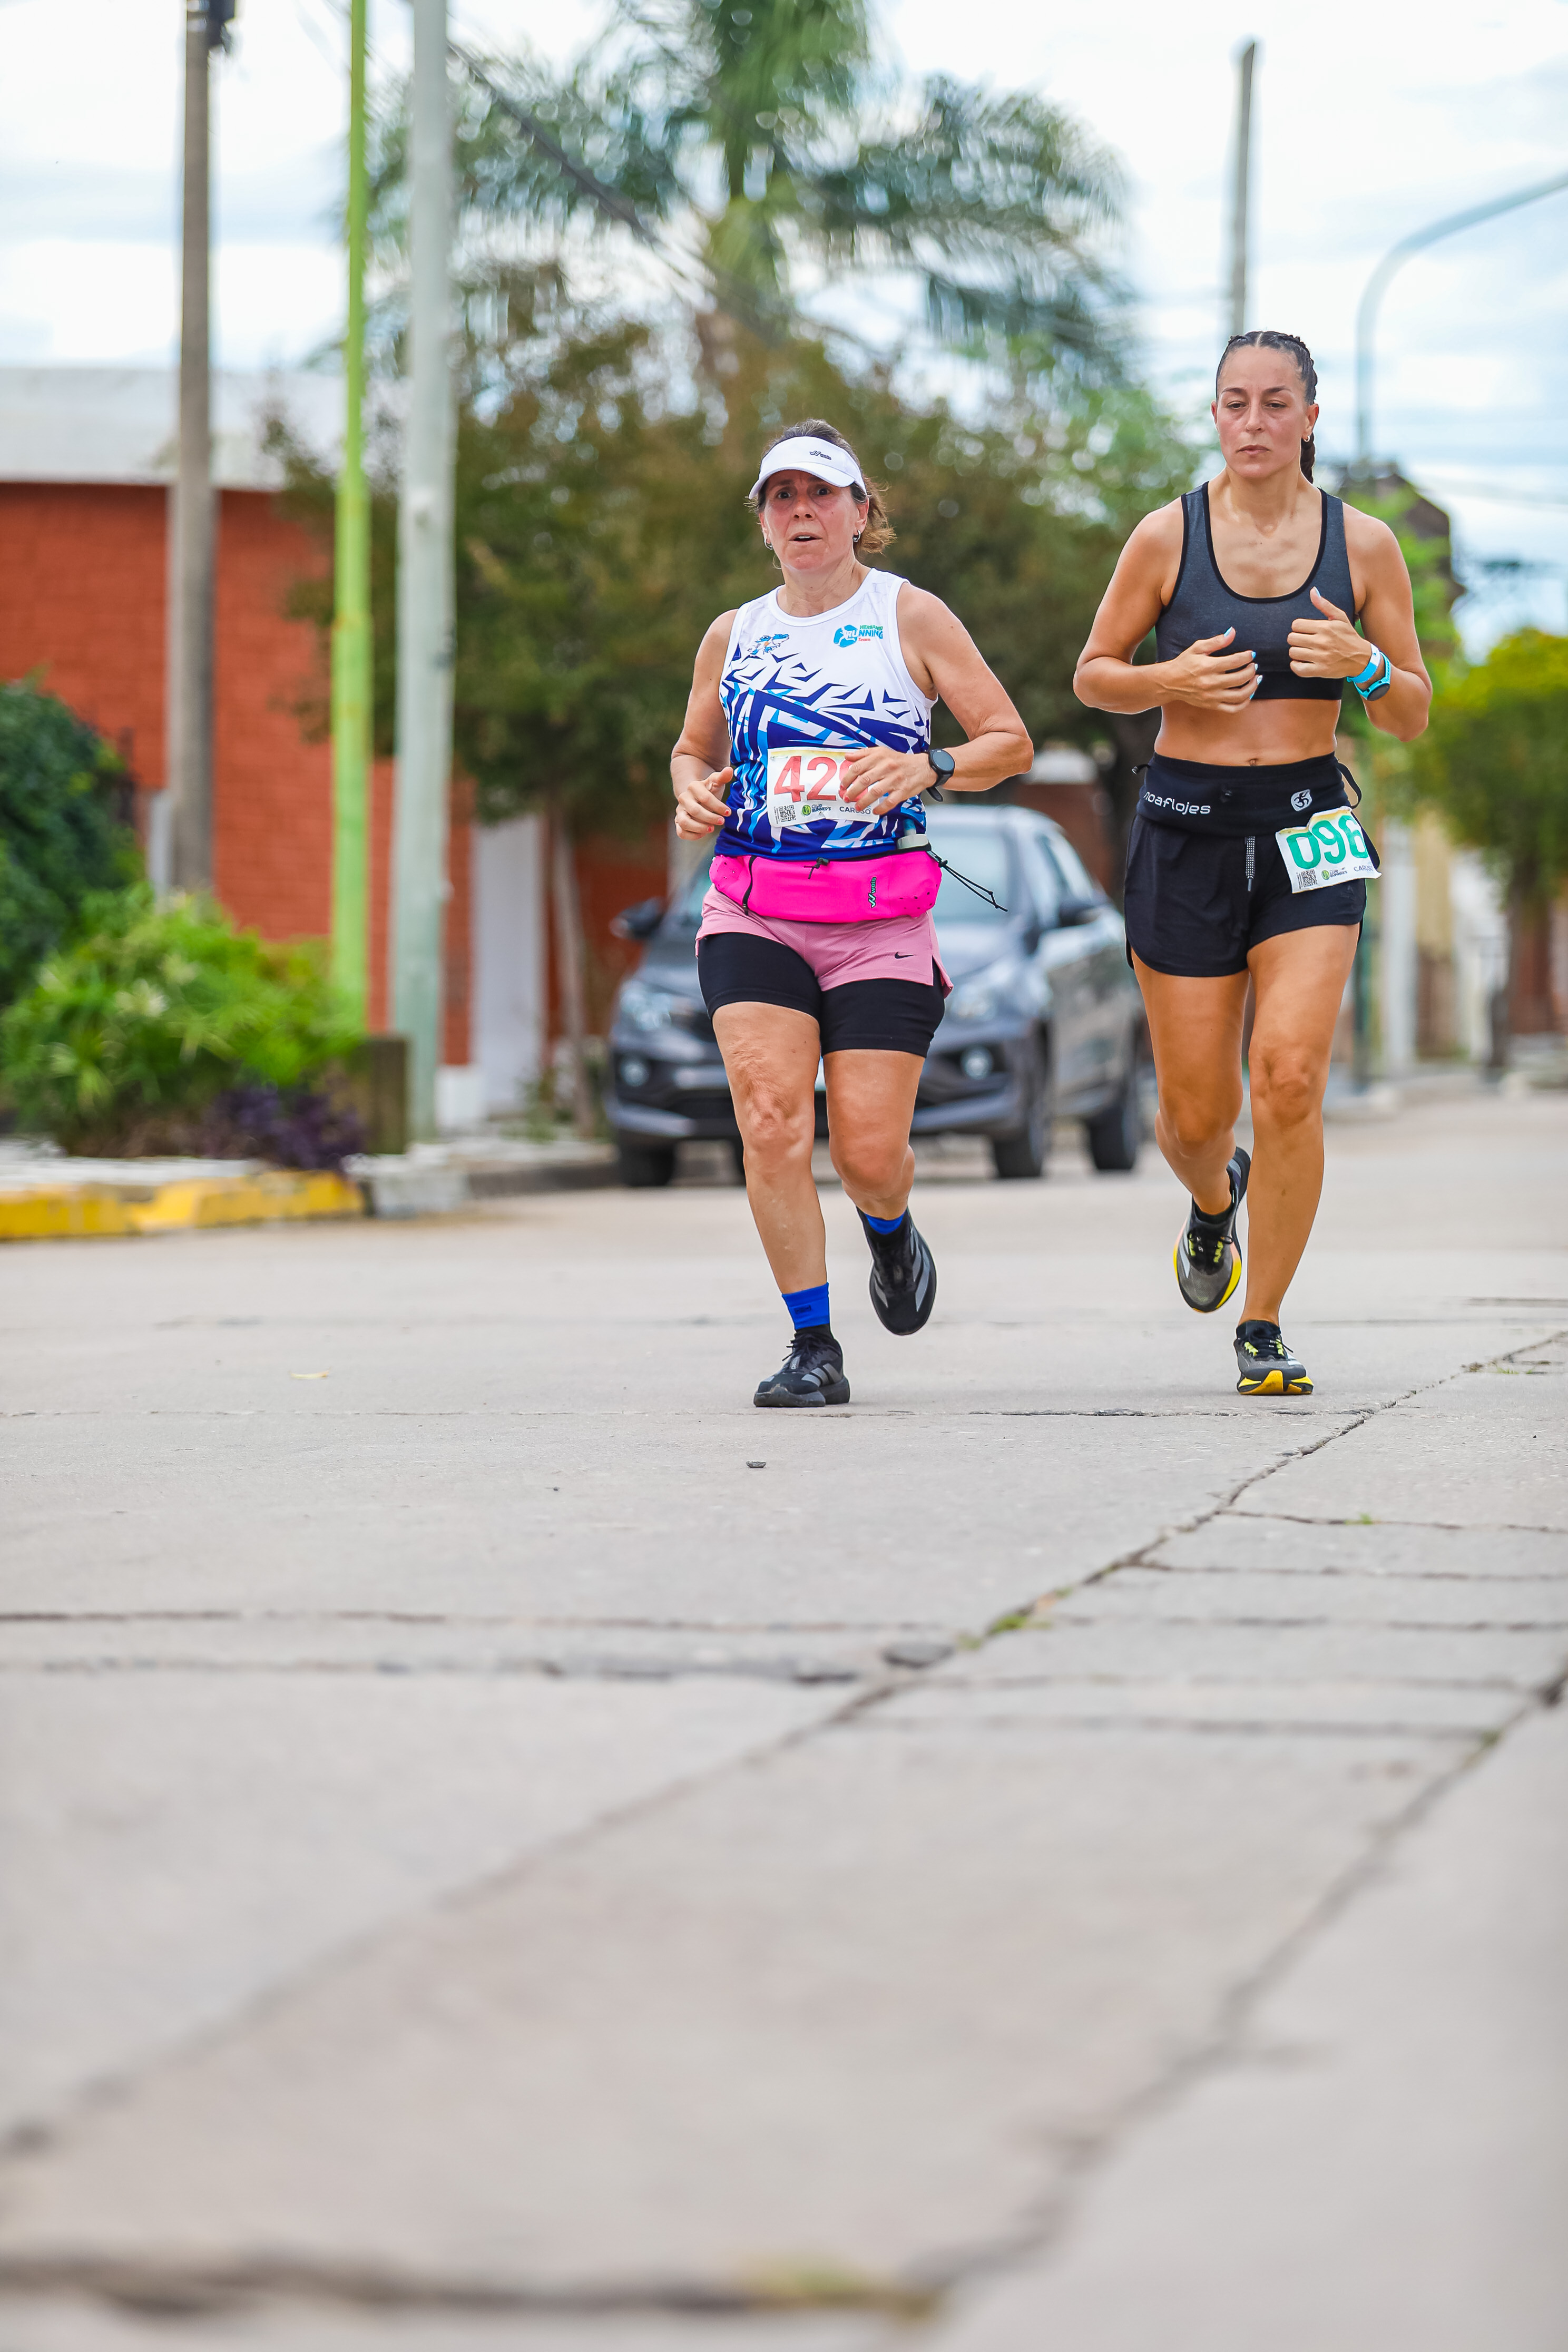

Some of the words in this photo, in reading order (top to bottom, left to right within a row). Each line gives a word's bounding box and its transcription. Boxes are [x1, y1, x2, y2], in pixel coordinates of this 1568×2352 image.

[846, 629, 883, 639] RUNNING
[1143, 791, 1211, 815] noaflojes
[1286, 815, 1369, 869] 096
